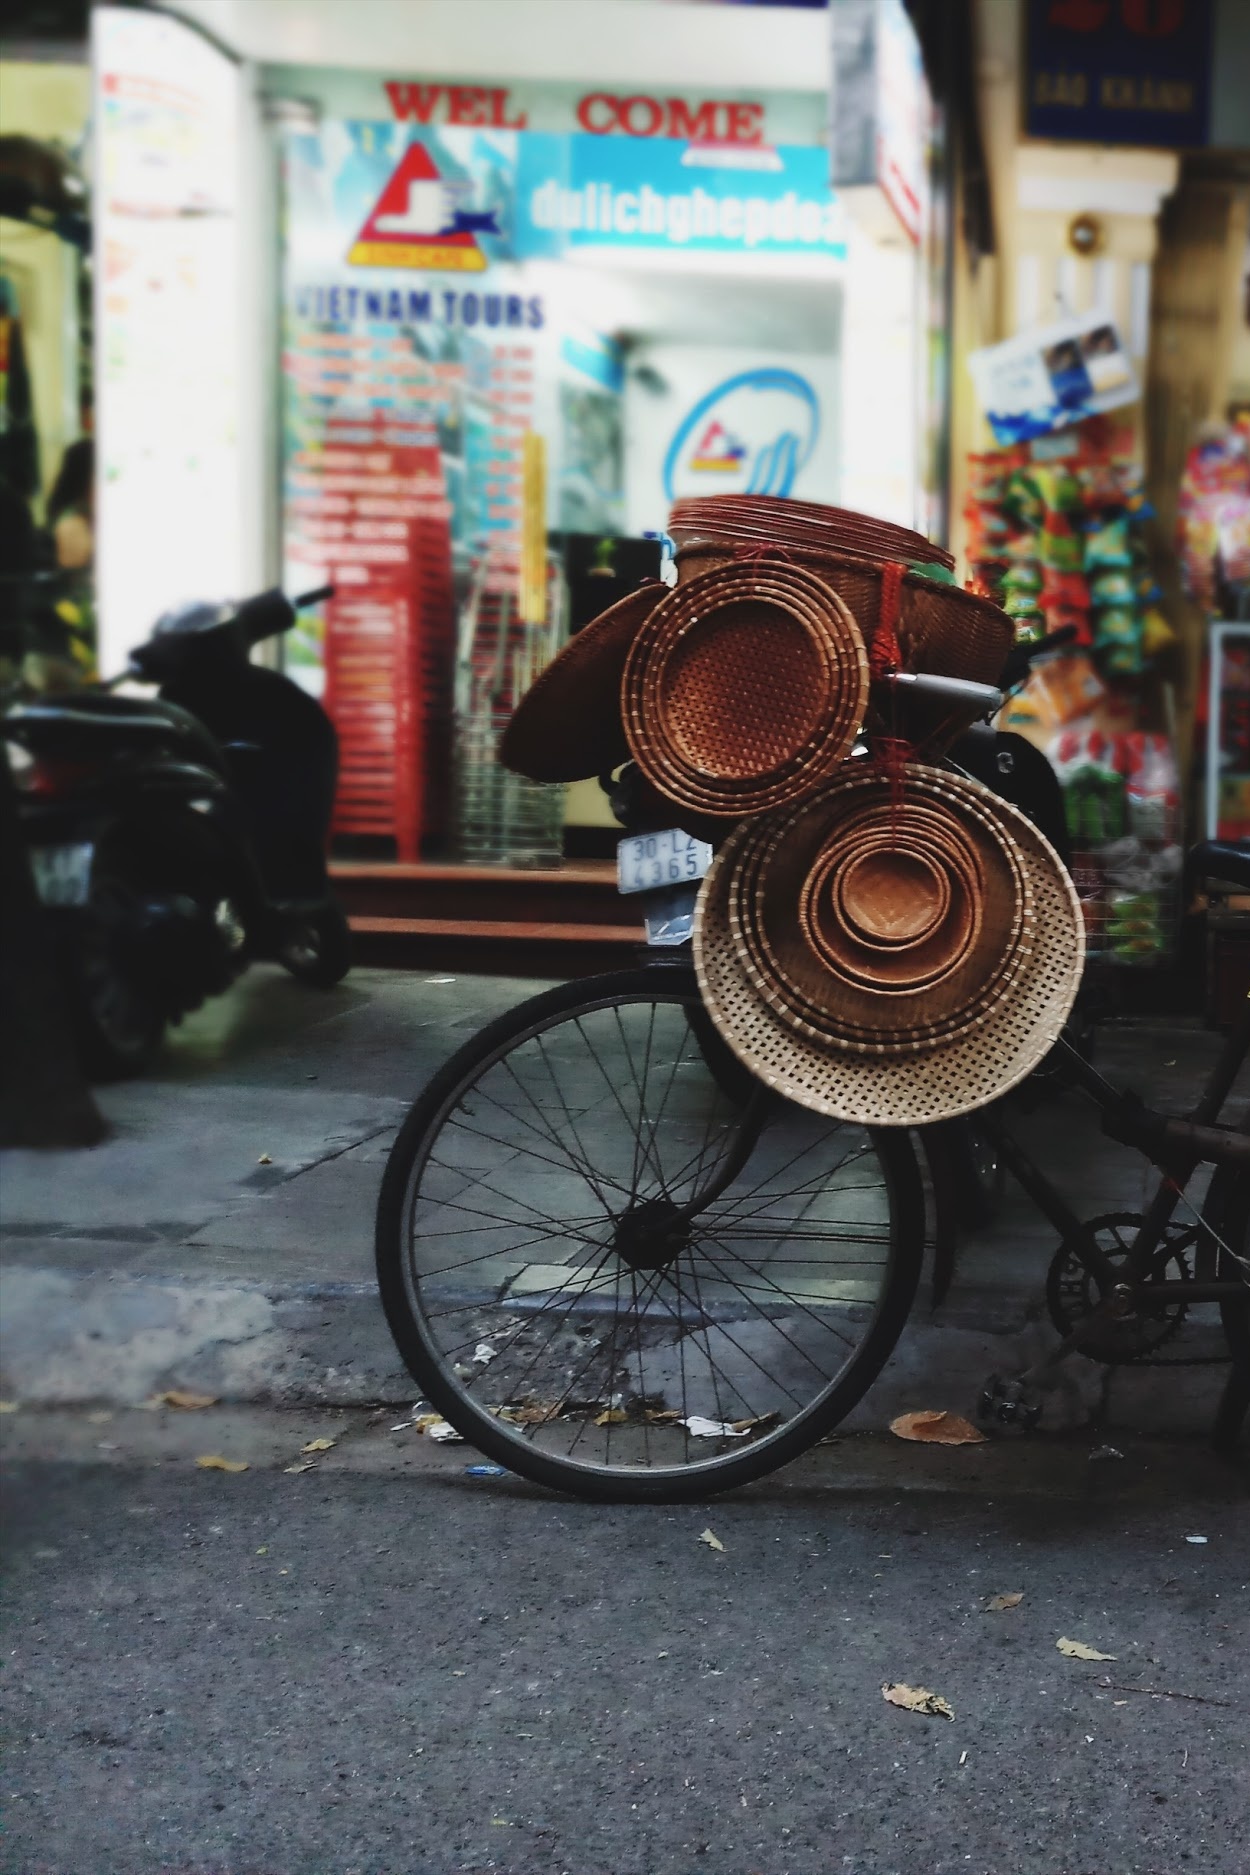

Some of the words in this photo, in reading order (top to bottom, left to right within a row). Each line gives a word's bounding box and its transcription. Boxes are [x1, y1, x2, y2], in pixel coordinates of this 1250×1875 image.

[384, 81, 527, 129] WEL
[577, 92, 764, 144] COME
[296, 286, 432, 323] VIETNAM
[443, 290, 544, 329] TOURS
